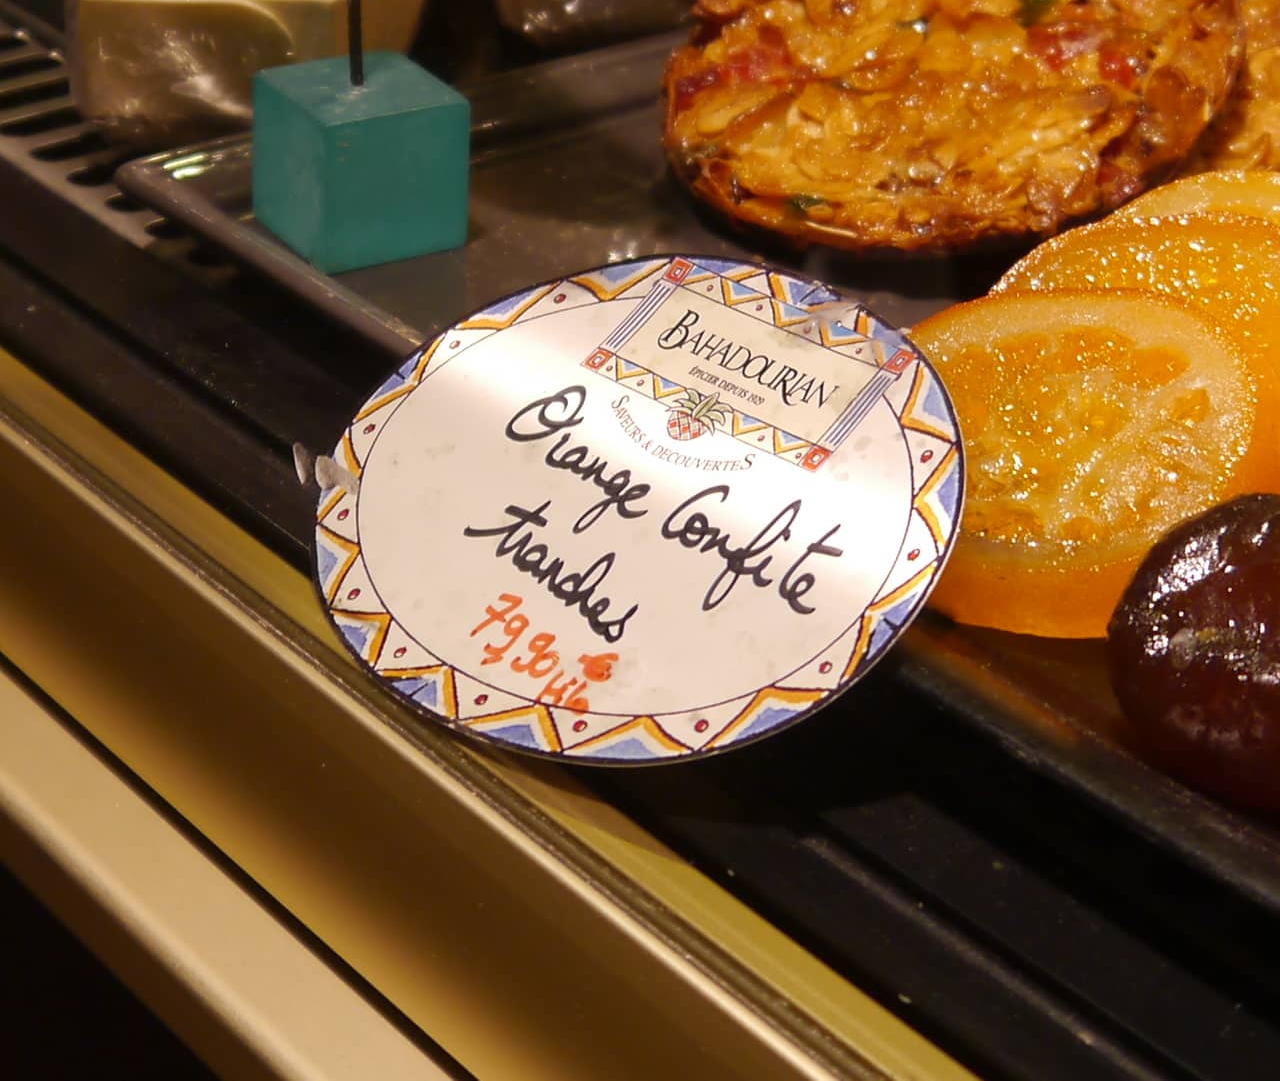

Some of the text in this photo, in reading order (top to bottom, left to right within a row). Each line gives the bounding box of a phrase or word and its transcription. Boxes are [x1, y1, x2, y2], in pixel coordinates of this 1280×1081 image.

[657, 308, 842, 409] BAHADOURIAN
[687, 365, 766, 406] ÉPICIER DEPUIS 1929
[505, 384, 651, 534] Orange
[611, 394, 646, 444] SAVEURS
[640, 439, 655, 452] &
